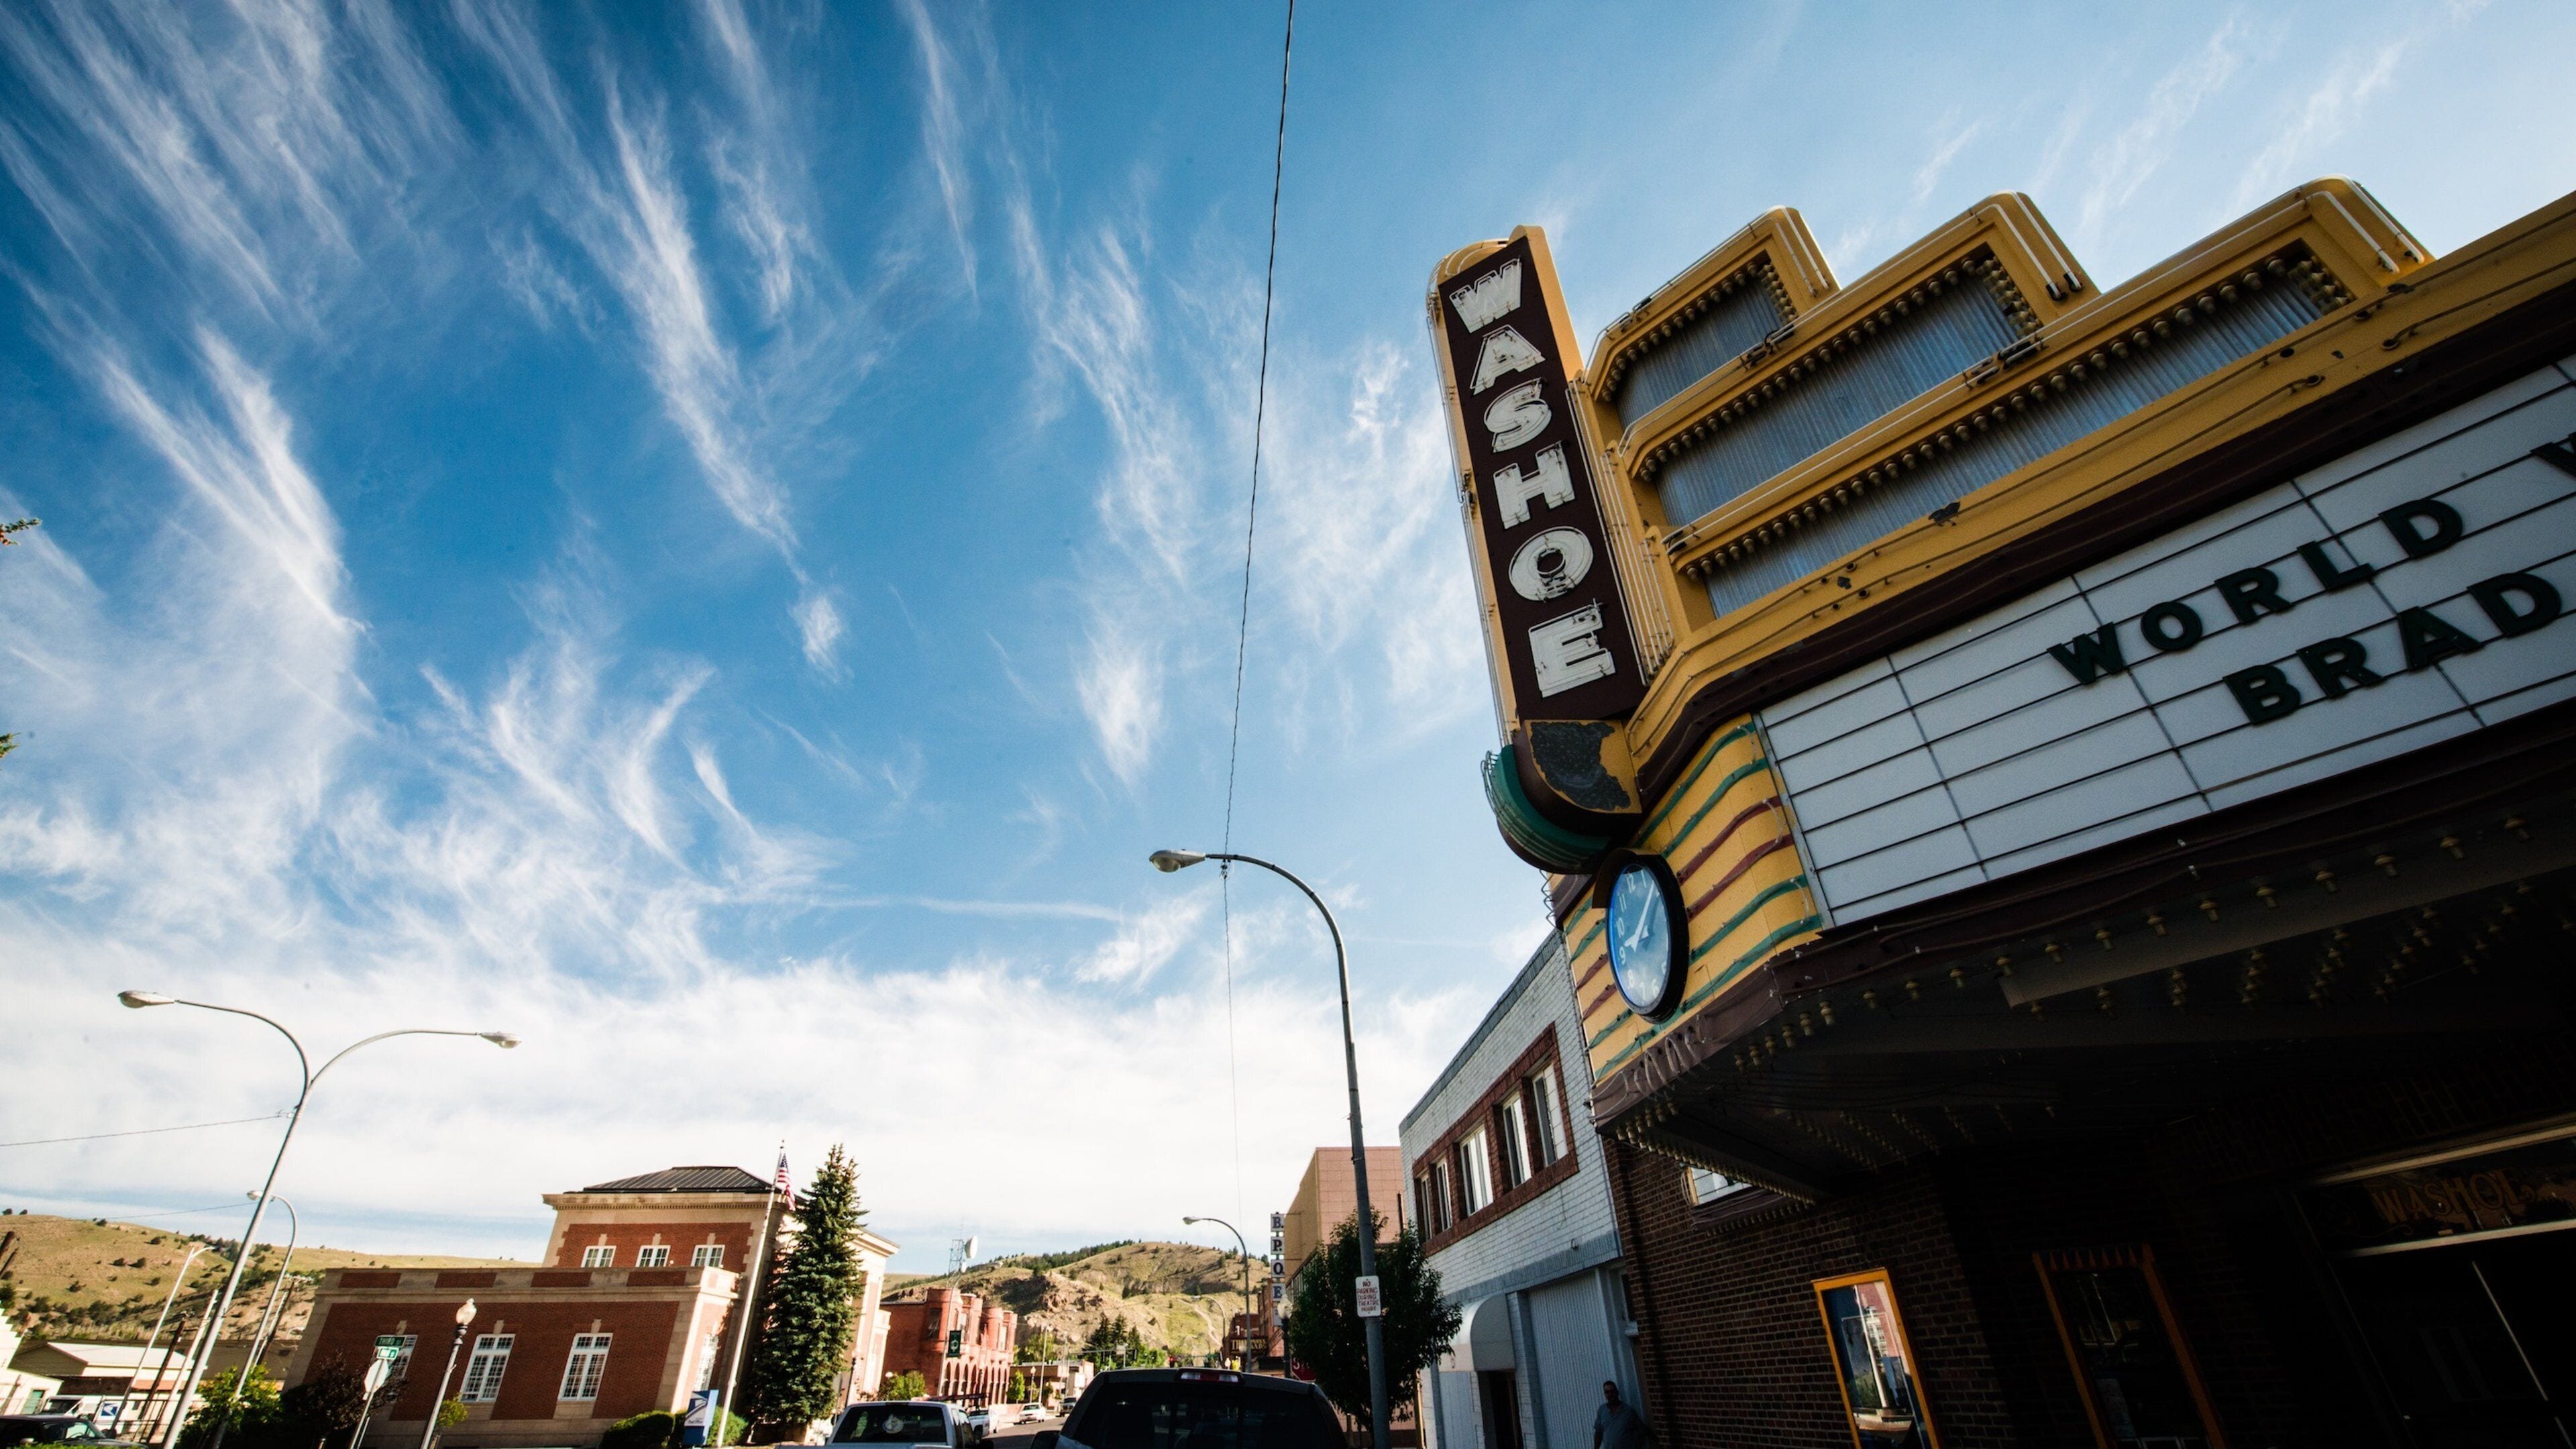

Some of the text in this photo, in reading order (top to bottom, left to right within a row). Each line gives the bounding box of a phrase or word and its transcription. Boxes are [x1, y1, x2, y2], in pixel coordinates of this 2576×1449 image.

[1449, 256, 1616, 698] WASHOE
[2047, 498, 2465, 686] WORLD
[2222, 572, 2563, 726] BRAD
